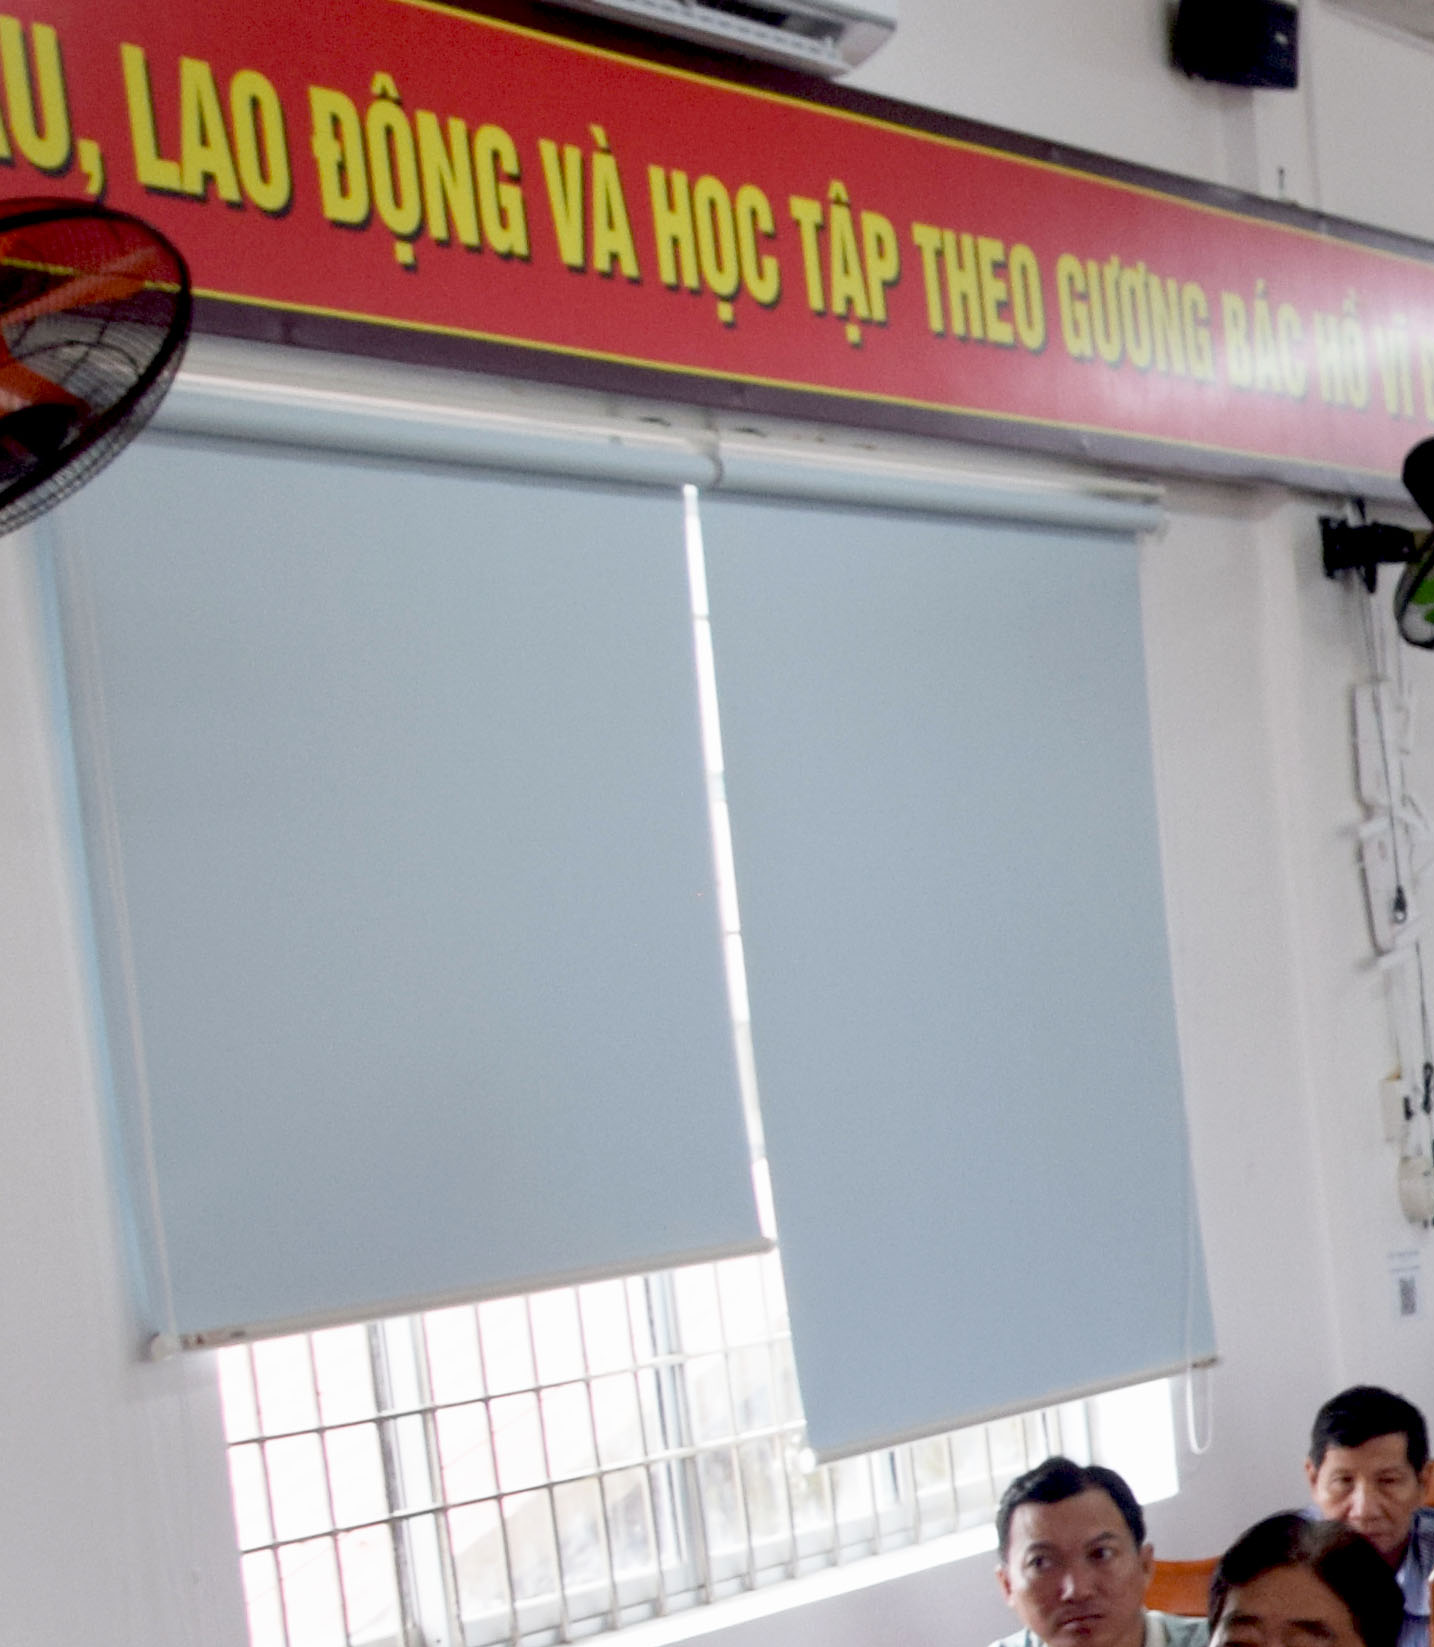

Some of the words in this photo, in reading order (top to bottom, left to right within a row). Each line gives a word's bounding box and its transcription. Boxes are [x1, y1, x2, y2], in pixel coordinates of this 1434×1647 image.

[0, 14, 104, 196] U,
[120, 42, 293, 214] LAO
[308, 71, 531, 267] ĐỘNG
[539, 124, 641, 281] VÀ
[647, 161, 781, 324] HỌC
[790, 179, 900, 346] TẬP
[912, 223, 1046, 354] THEO
[1056, 252, 1216, 382] GƯƠNG
[1221, 278, 1307, 401] BÁC
